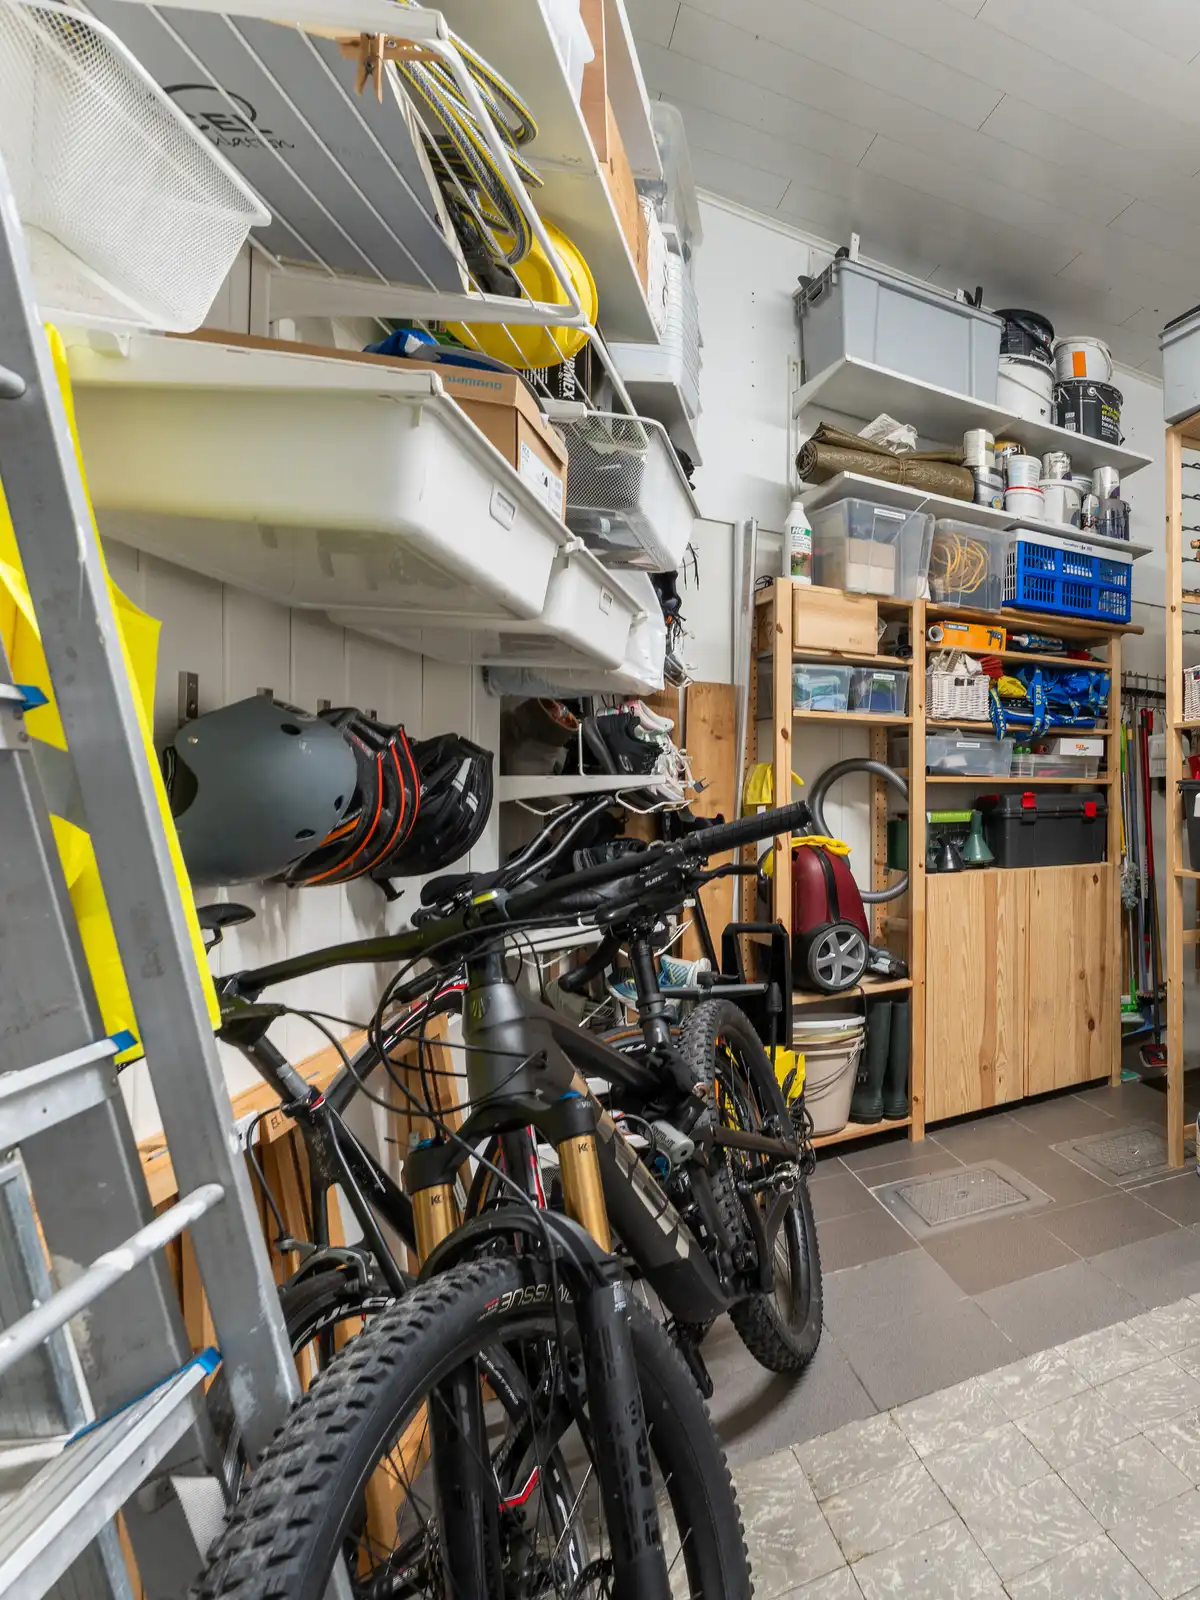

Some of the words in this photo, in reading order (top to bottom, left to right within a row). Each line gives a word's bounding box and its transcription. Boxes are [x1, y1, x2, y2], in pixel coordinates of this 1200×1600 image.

[444, 374, 503, 391] SHIMANO
[791, 527, 805, 535] HG
[644, 875, 662, 888] SLATE
[498, 1283, 552, 1314] ISSUE
